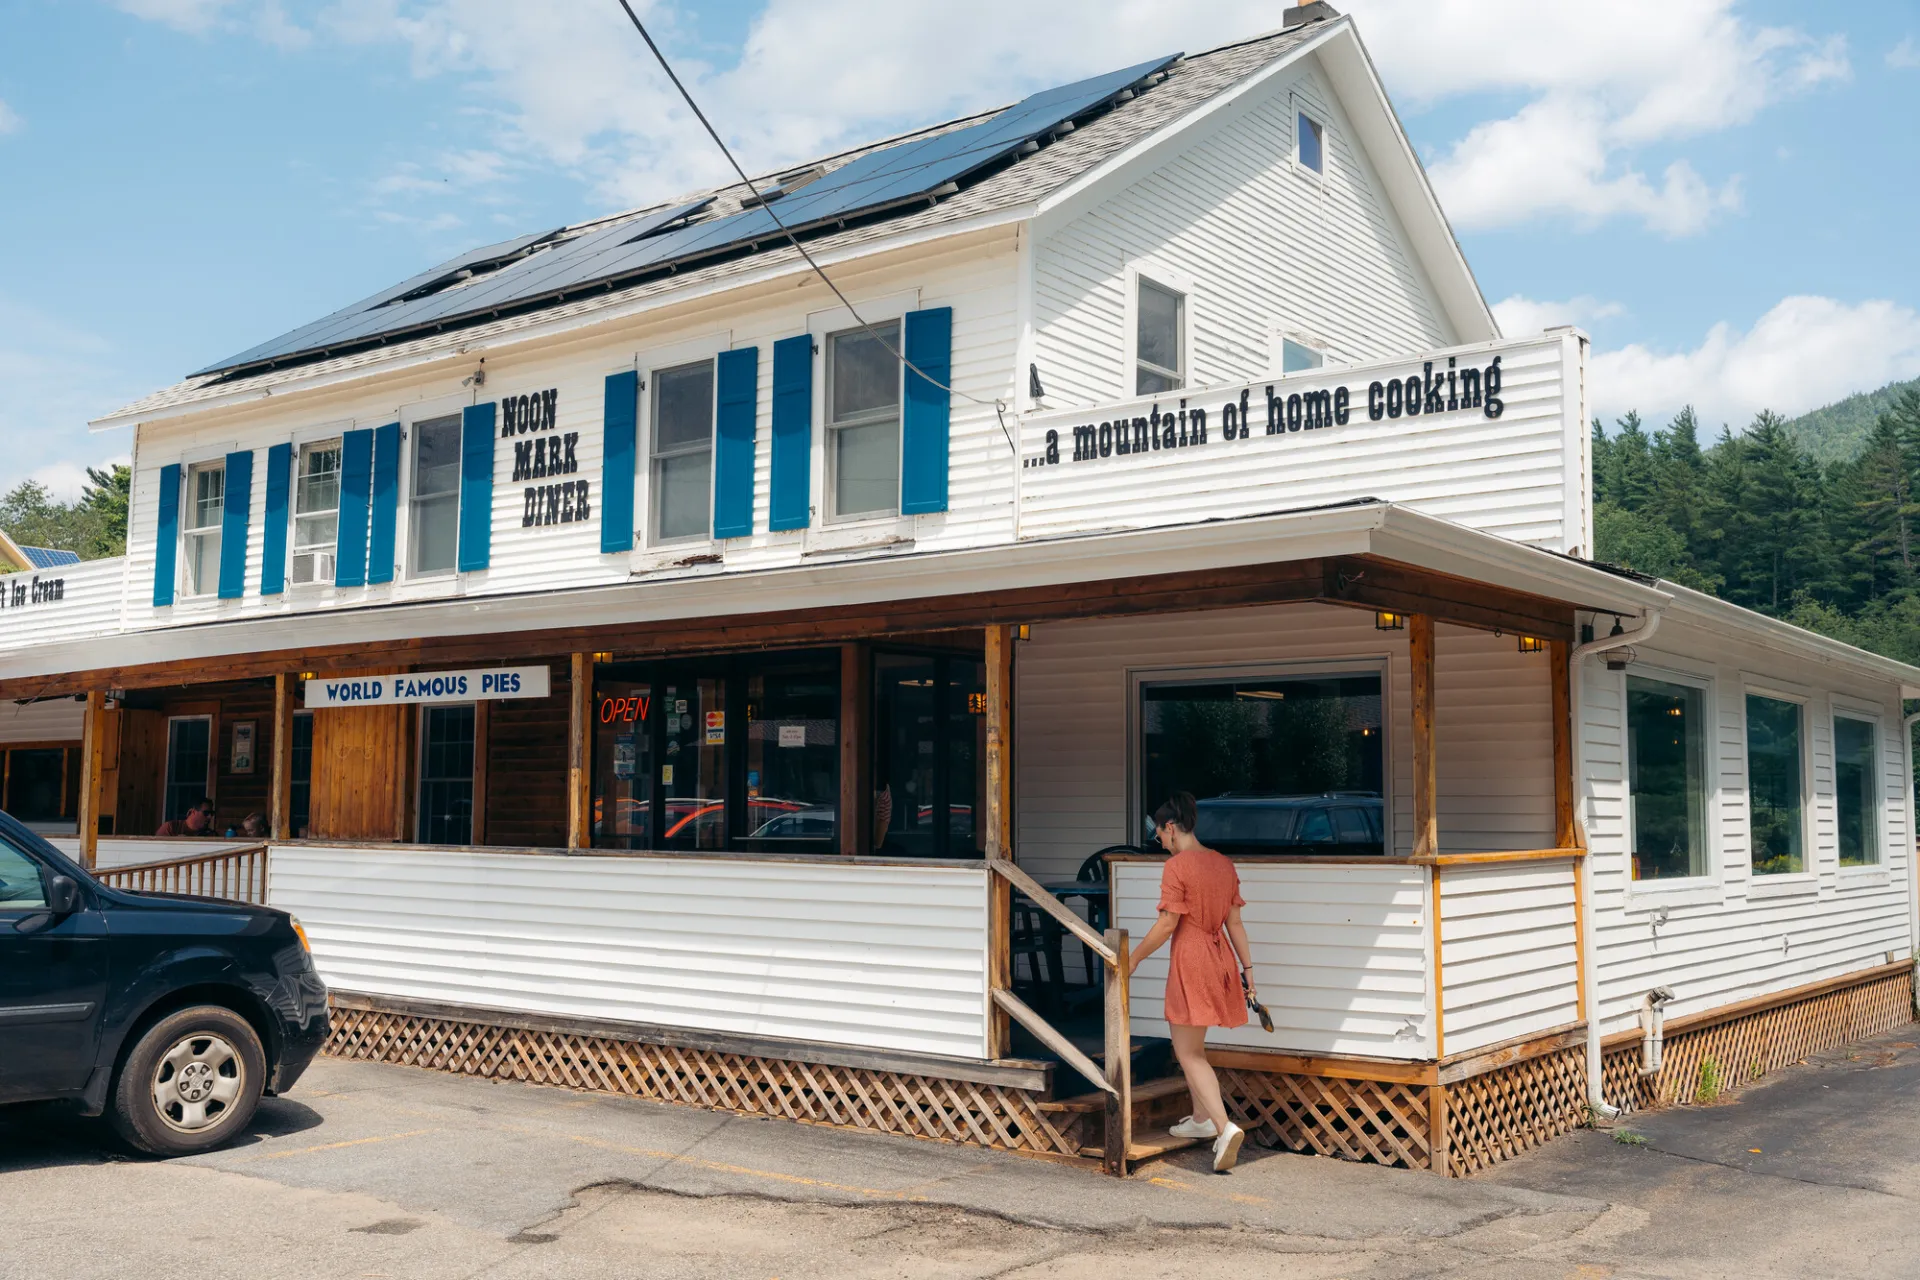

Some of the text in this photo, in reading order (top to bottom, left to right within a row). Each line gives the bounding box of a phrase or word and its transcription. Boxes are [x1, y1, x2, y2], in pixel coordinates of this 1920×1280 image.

[501, 388, 558, 438] NOON
[1073, 398, 1207, 462] mountain
[1222, 388, 1250, 441] of
[1265, 385, 1350, 436] home
[1368, 355, 1504, 421] cooking
[512, 431, 579, 482] MARK
[522, 479, 591, 528] DINER
[10, 579, 27, 607] Ice
[32, 575, 65, 603] Cream
[326, 672, 521, 702] WORLD FAMOUS PIES
[600, 696, 651, 723] OPEN
